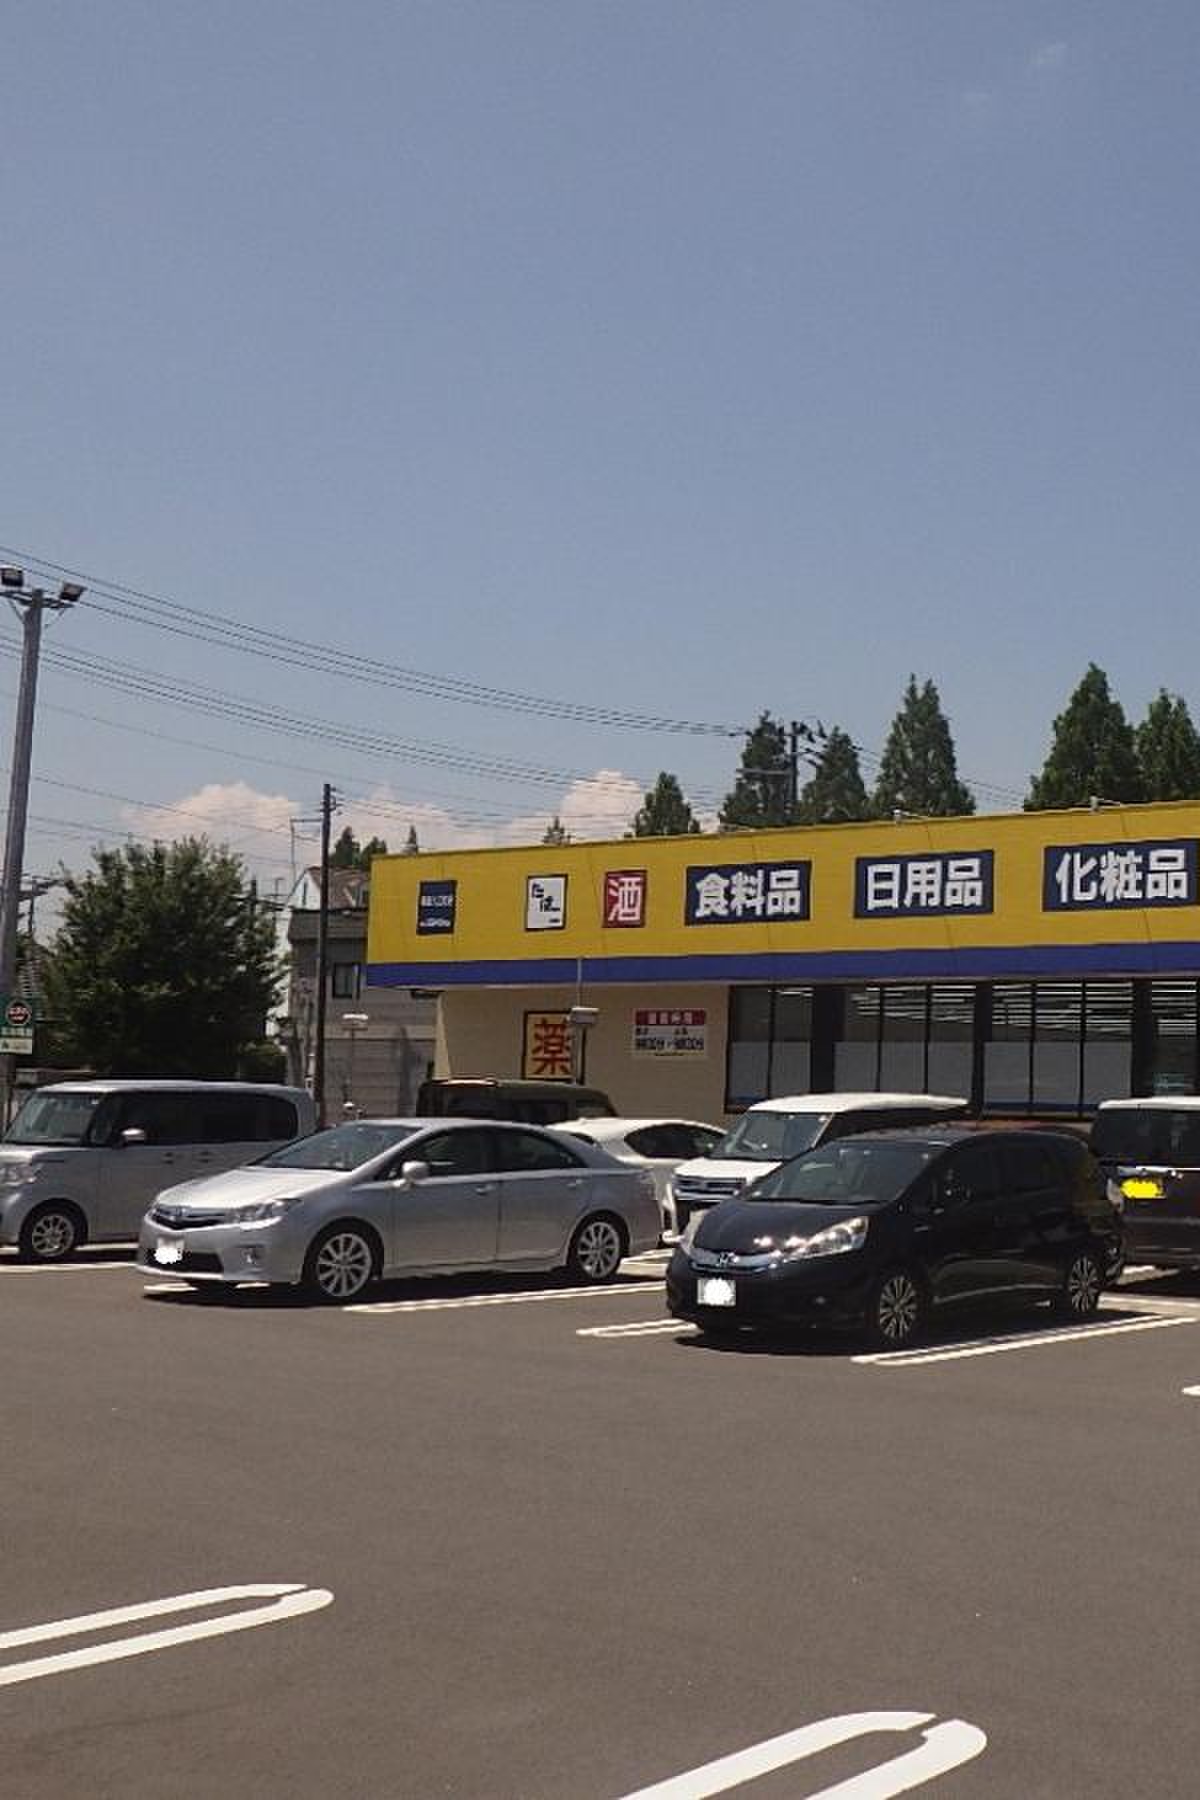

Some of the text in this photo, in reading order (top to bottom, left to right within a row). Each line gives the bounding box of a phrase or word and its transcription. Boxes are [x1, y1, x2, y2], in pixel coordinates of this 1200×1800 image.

[607, 877, 642, 922] 酒
[695, 868, 801, 917] 食料品
[866, 857, 983, 911] 日用品
[1055, 848, 1188, 903] 化粧品
[531, 1017, 574, 1075] 薬
